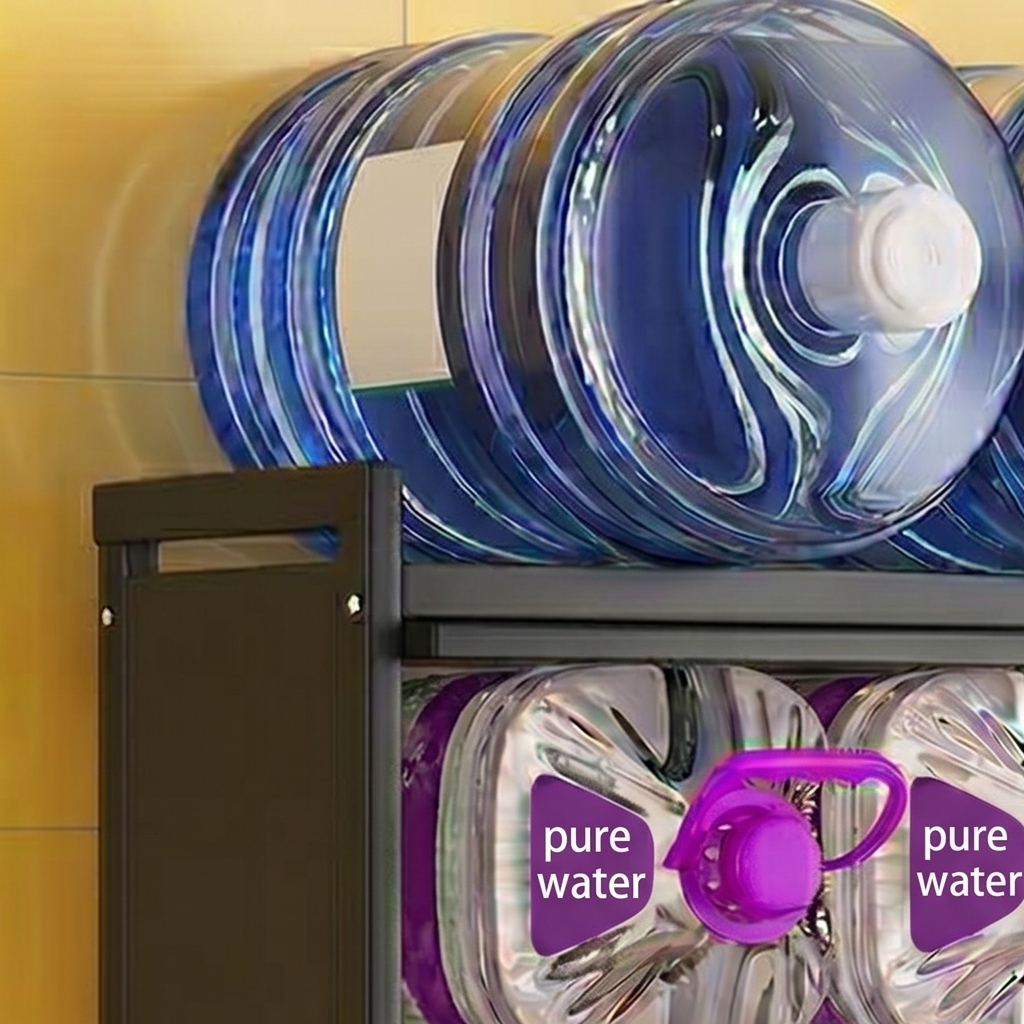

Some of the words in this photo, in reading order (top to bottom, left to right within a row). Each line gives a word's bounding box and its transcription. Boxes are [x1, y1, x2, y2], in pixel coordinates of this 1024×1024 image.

[545, 826, 631, 862] pure
[924, 826, 1008, 861] pure
[537, 868, 646, 899] water
[916, 867, 1023, 897] water
